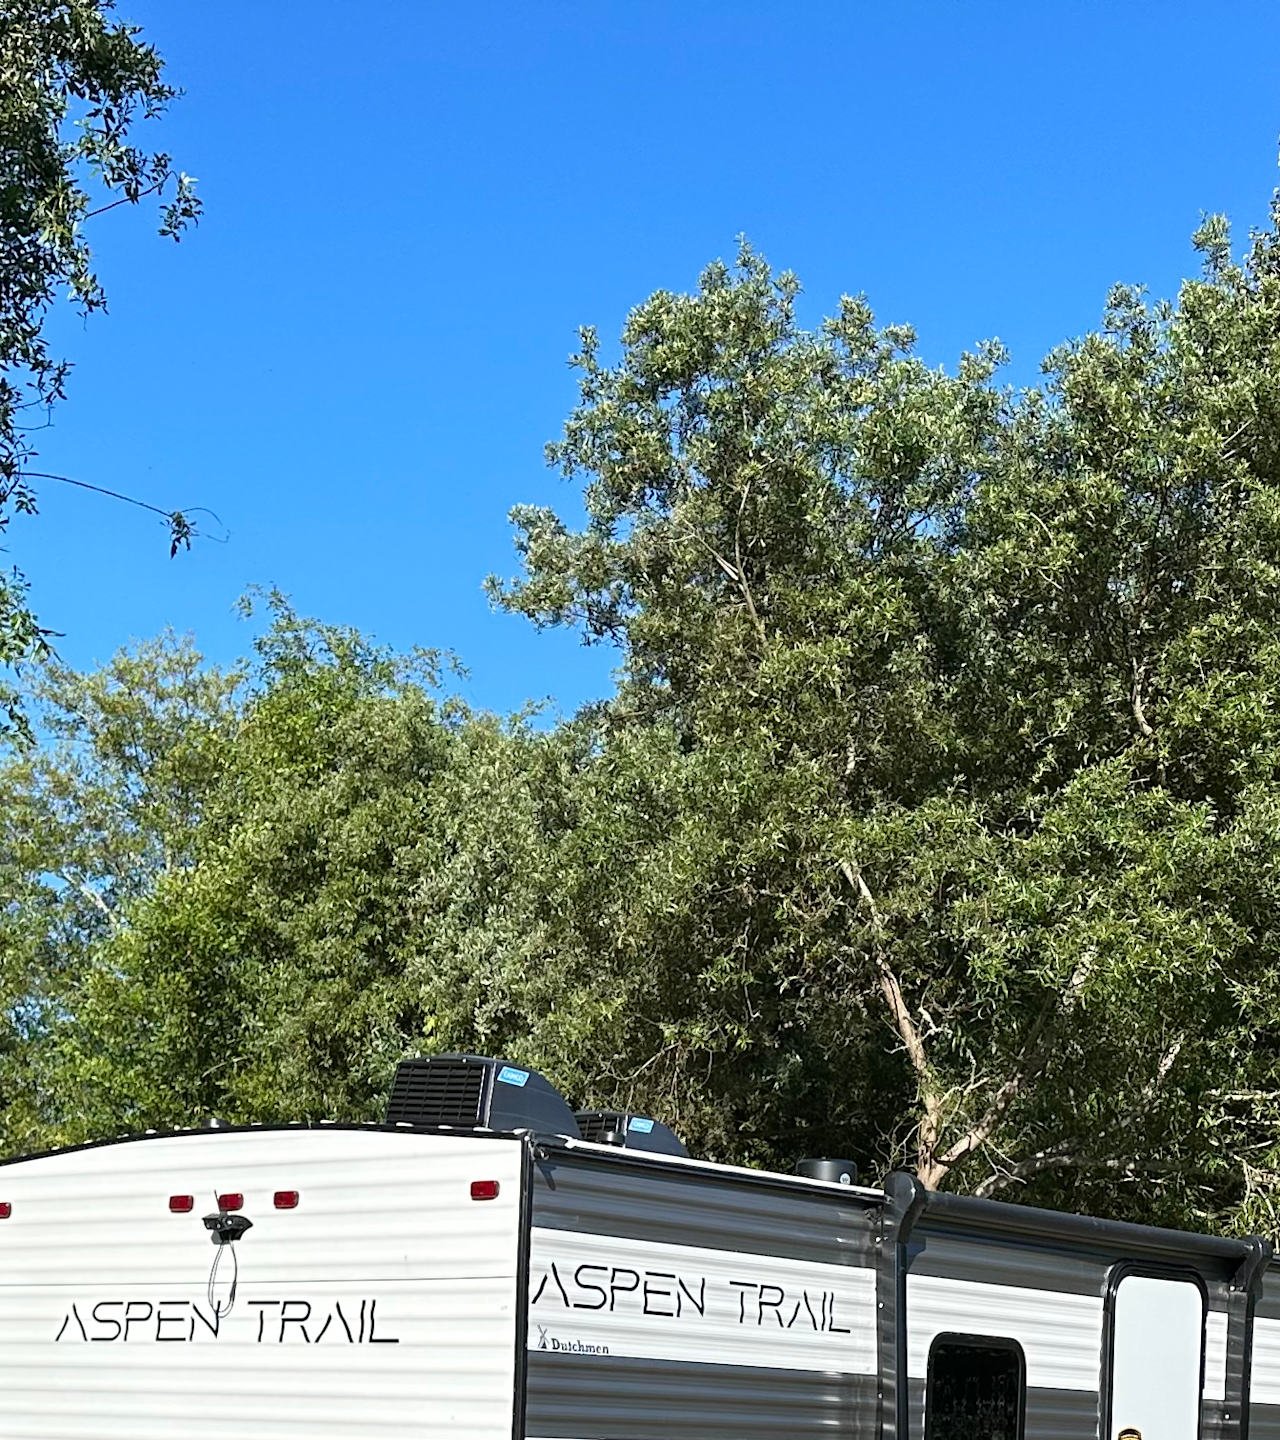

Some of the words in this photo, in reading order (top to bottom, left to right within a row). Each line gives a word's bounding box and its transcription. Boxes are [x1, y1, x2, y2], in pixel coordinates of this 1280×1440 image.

[531, 1262, 706, 1318] ASPEN
[729, 1280, 851, 1334] TRAIL
[54, 1299, 222, 1343] ASPEN
[247, 1299, 400, 1343] TRAIL
[550, 1337, 609, 1355] Dutchmen
